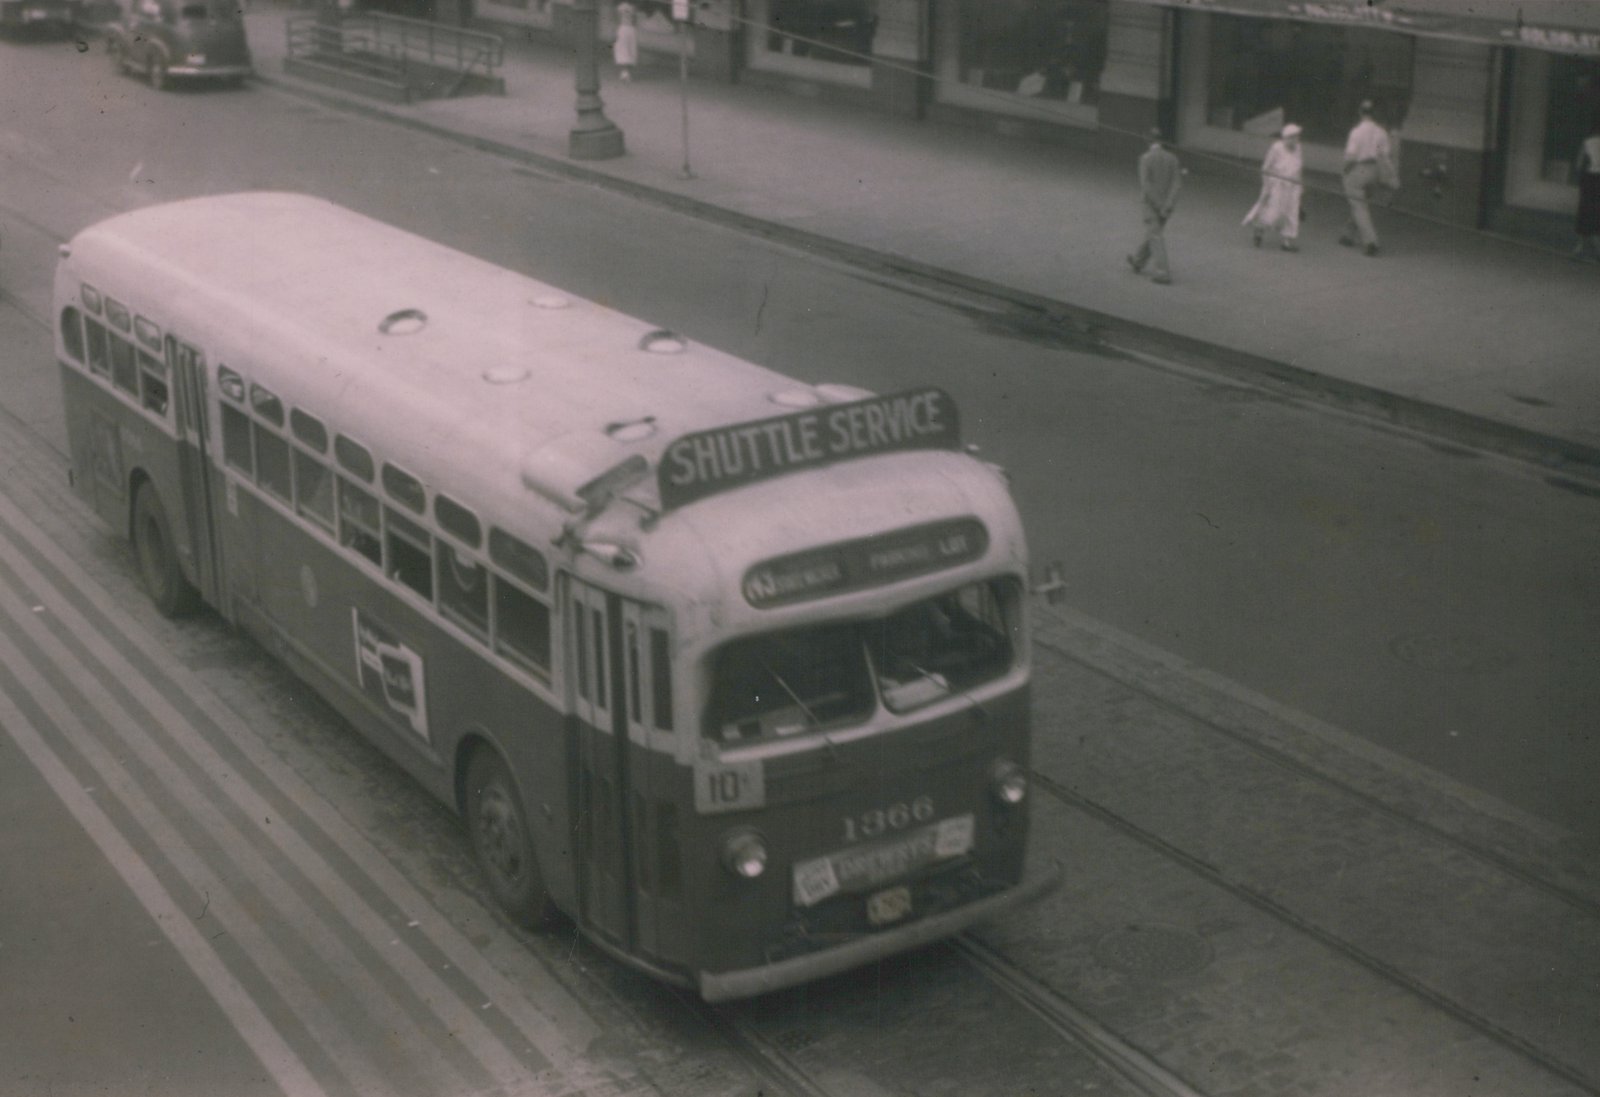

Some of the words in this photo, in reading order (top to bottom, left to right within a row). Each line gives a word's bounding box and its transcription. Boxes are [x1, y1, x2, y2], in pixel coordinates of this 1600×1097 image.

[672, 418, 823, 485] SHUTTLE
[829, 392, 944, 448] SERVICE
[843, 796, 934, 841] 1366
